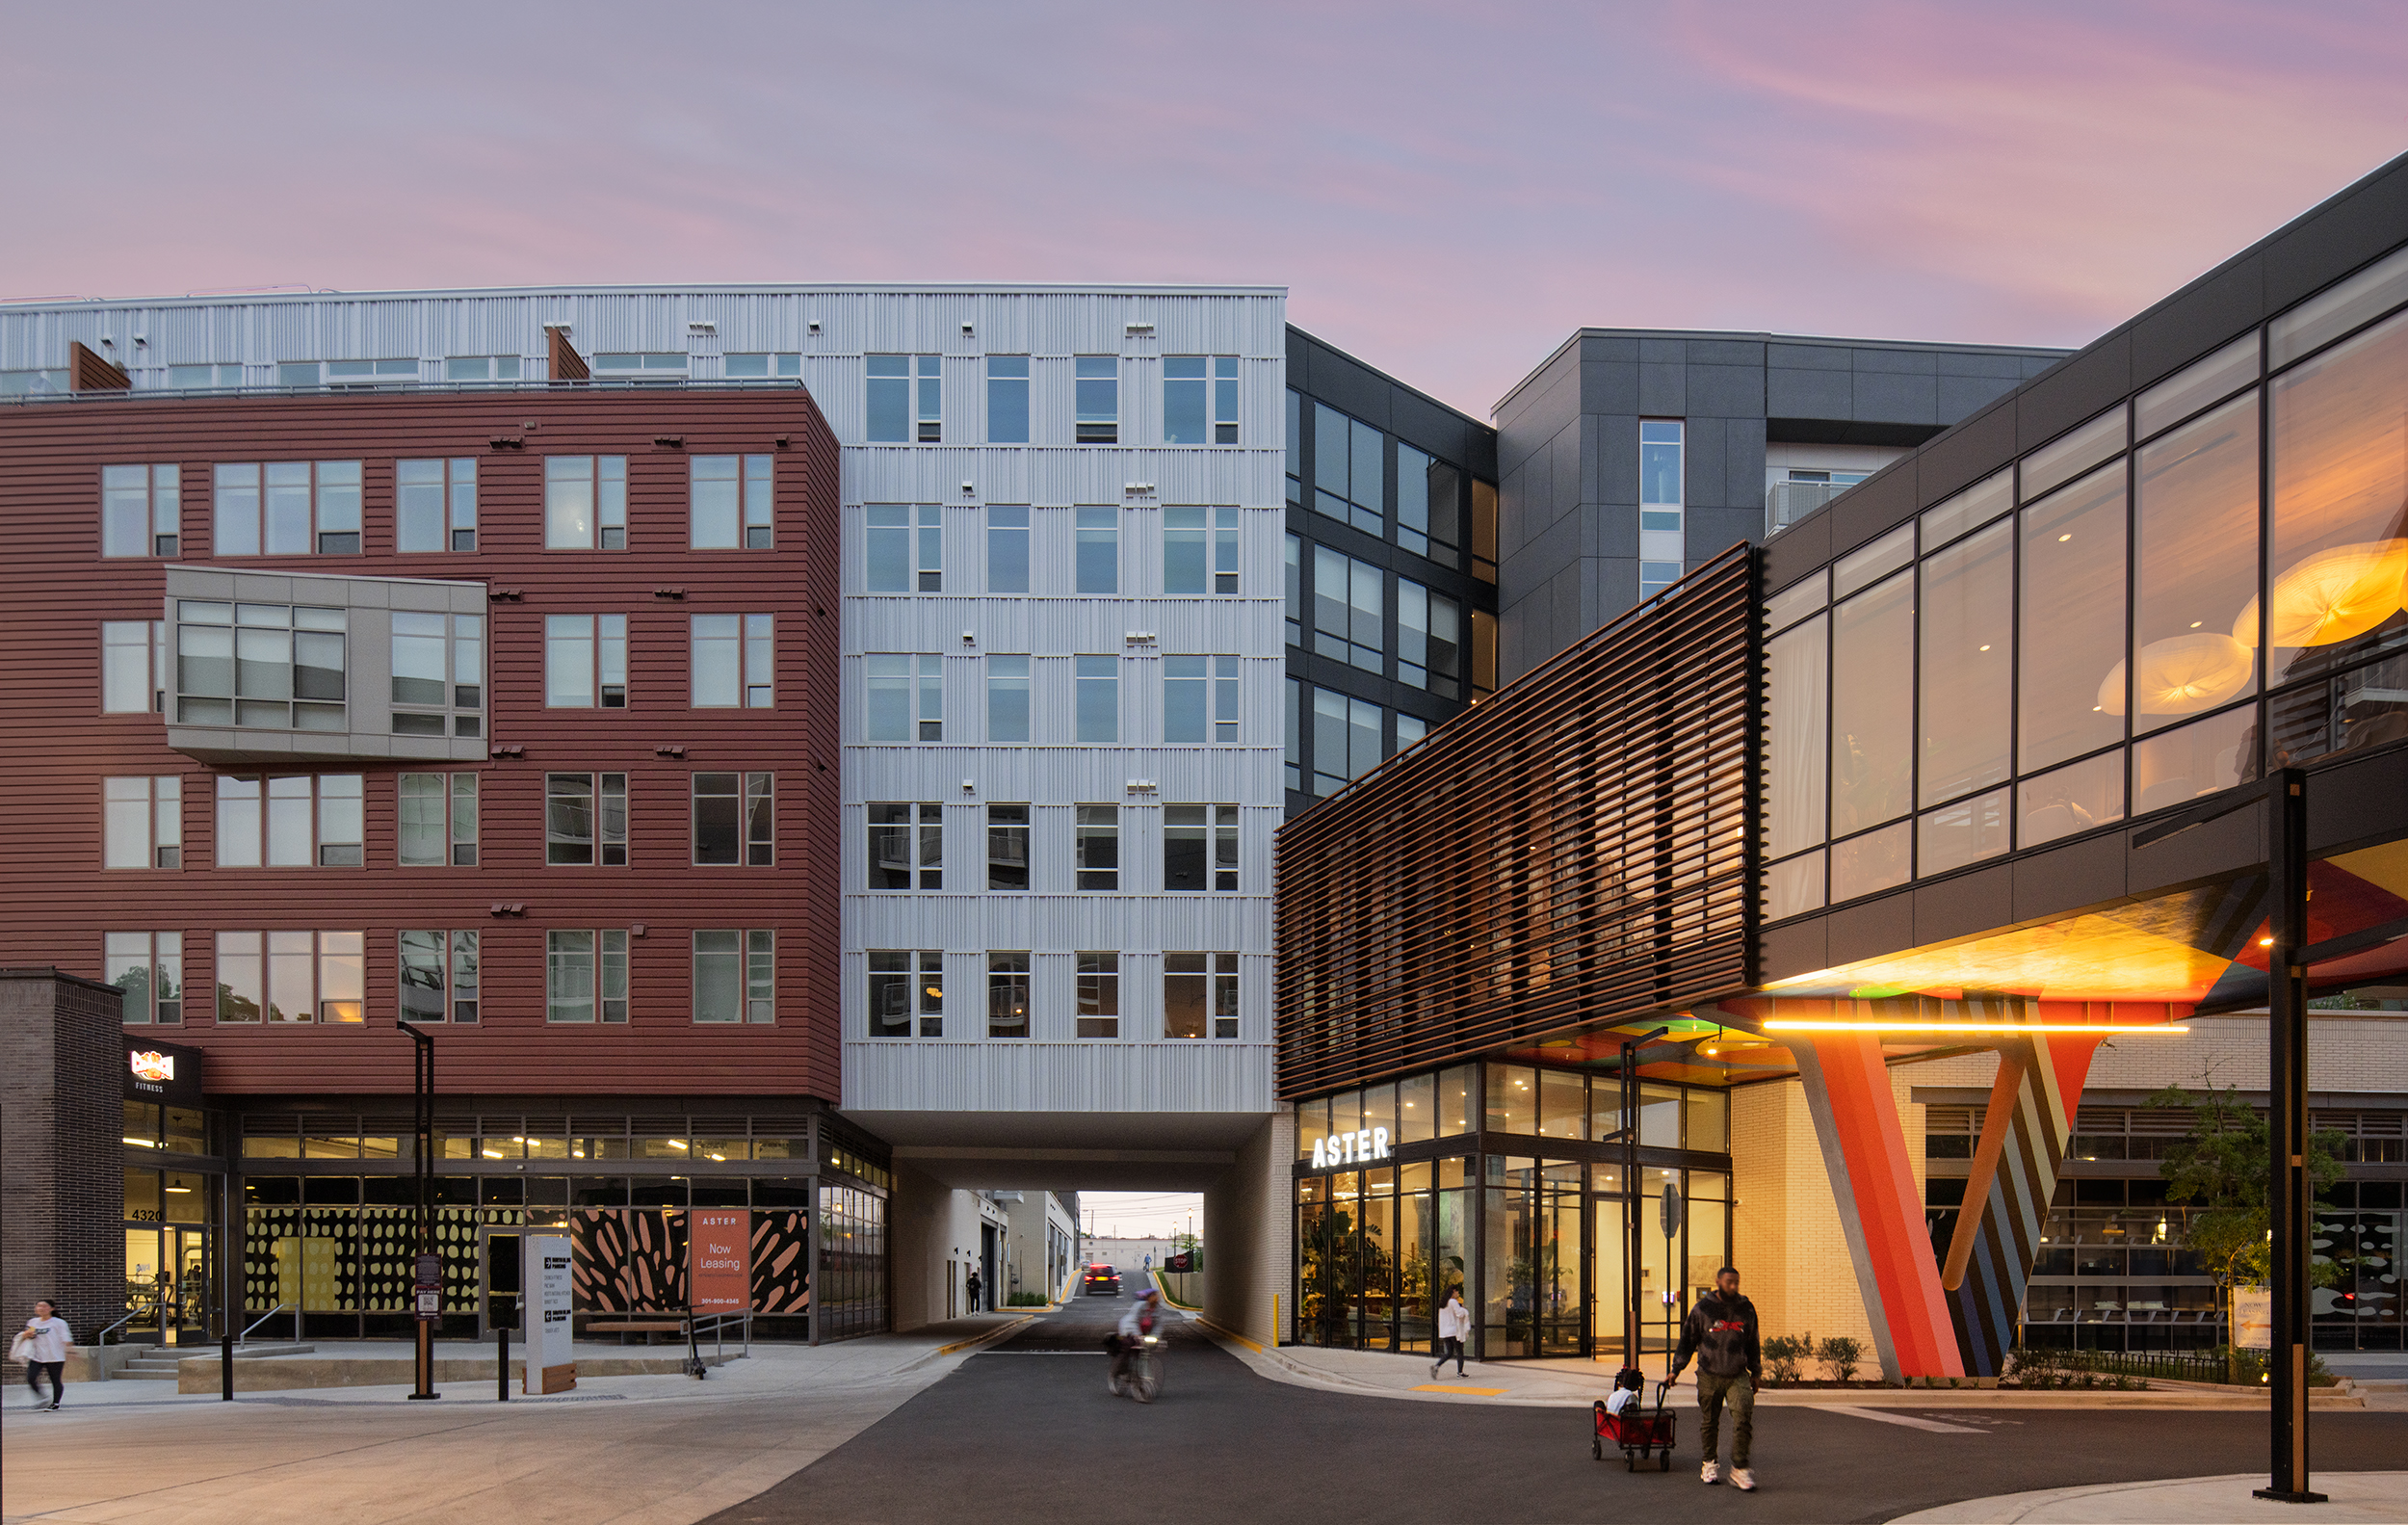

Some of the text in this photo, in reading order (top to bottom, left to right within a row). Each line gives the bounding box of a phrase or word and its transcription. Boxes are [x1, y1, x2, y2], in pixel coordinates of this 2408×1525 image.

[135, 1082, 164, 1093] FITNESS
[1312, 1126, 1389, 1169] ASTER
[132, 1209, 163, 1222] 4320
[702, 1217, 737, 1225] ASTER
[709, 1243, 732, 1254] Now
[700, 1257, 741, 1272] Leasing
